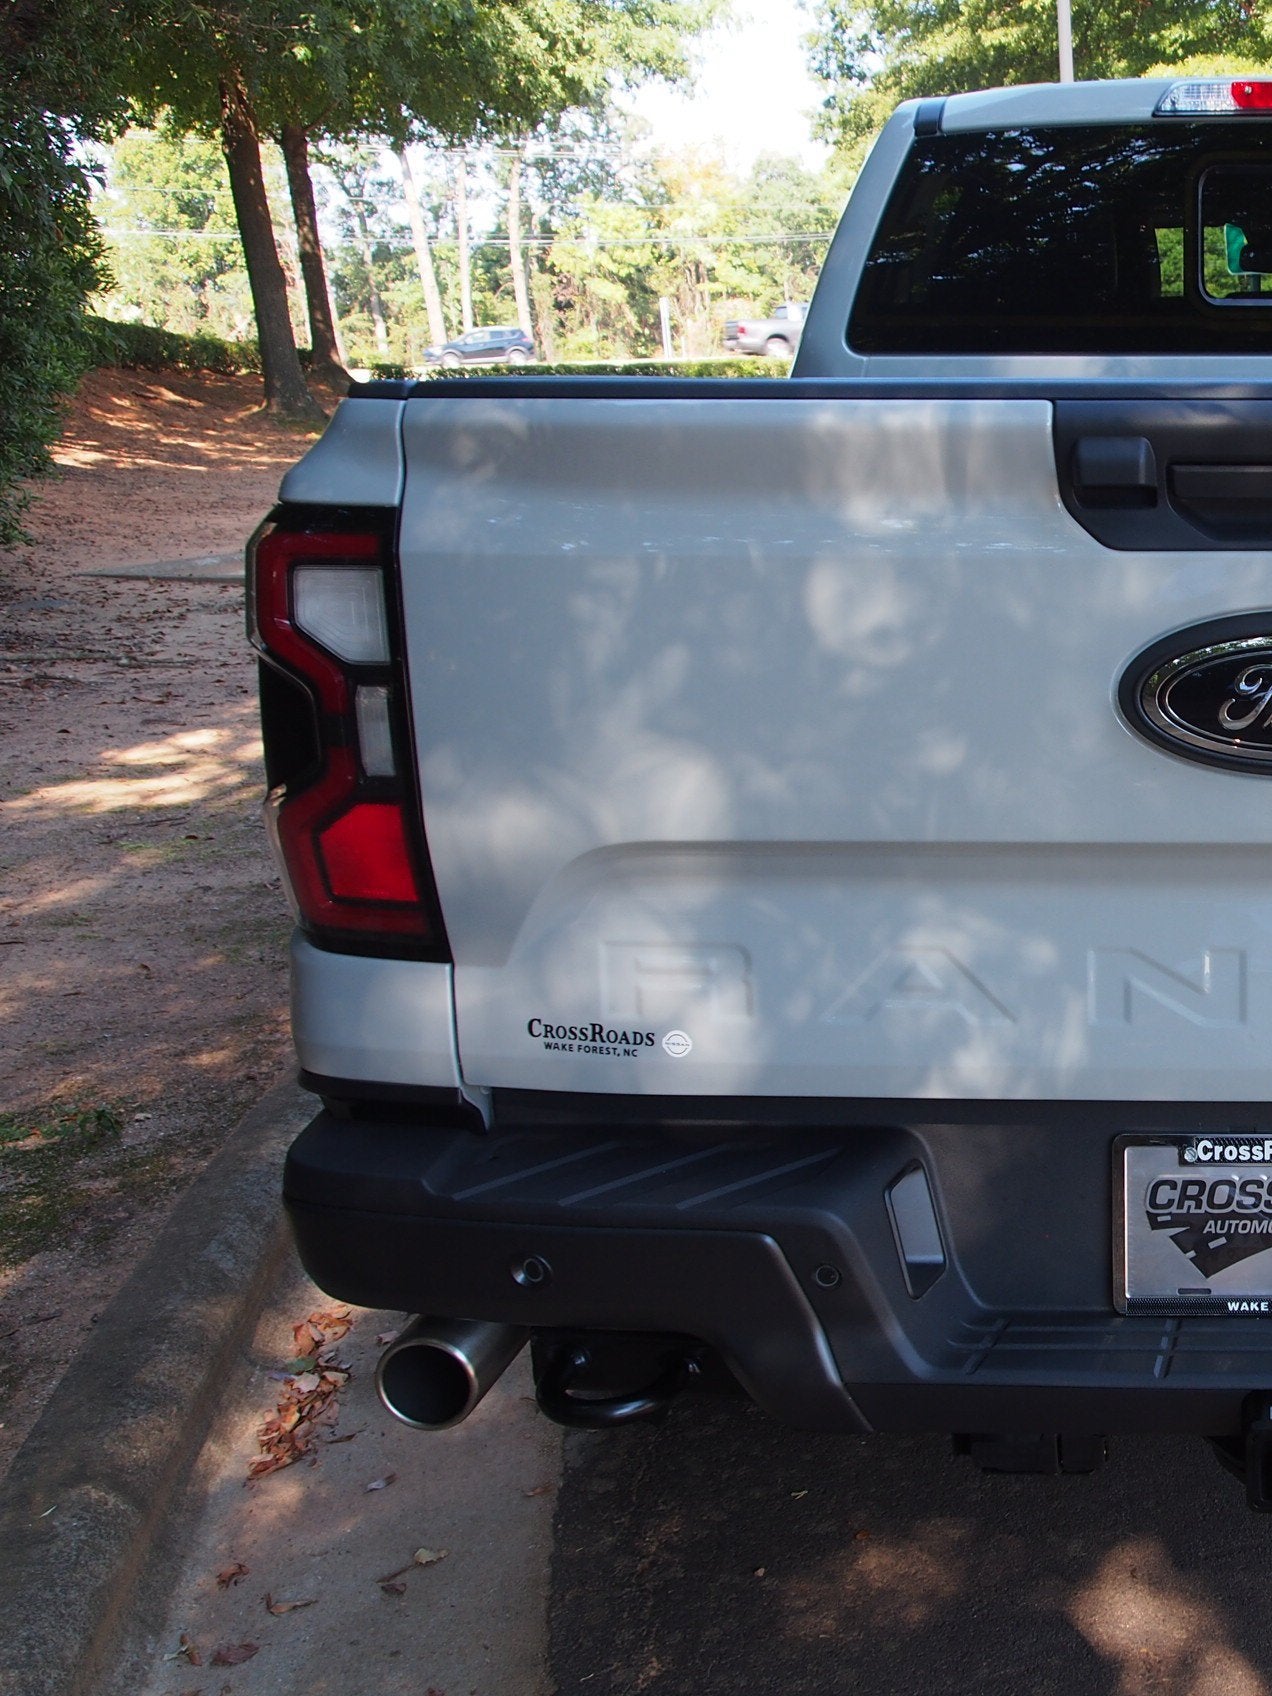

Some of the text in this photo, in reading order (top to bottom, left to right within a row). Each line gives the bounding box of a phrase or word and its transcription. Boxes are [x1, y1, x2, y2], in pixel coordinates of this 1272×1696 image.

[544, 1041, 638, 1058] WAKE FOREST, NC
[1227, 1301, 1269, 1312] WAKE
